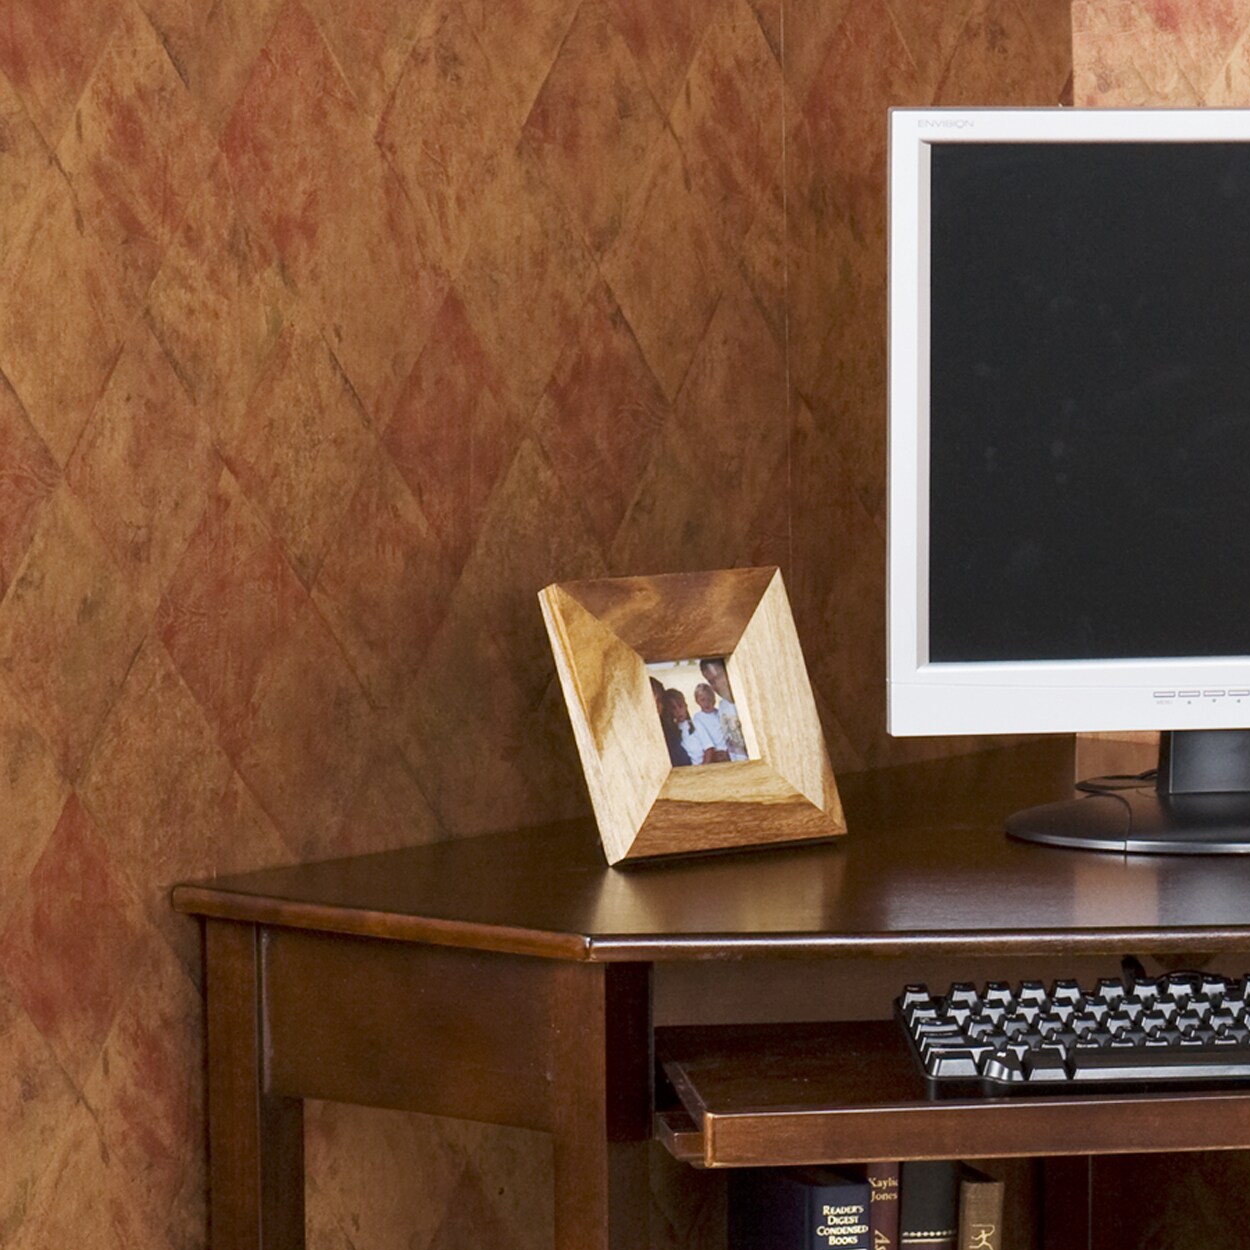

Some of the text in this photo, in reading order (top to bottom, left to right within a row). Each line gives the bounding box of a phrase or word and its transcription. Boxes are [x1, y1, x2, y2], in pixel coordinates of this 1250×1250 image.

[917, 119, 975, 129] ENVISION
[870, 1190, 898, 1202] Jones
[827, 1215, 859, 1226] DIGEST
[816, 1224, 869, 1236] CONDENSED
[828, 1235, 858, 1245] BOOKS
